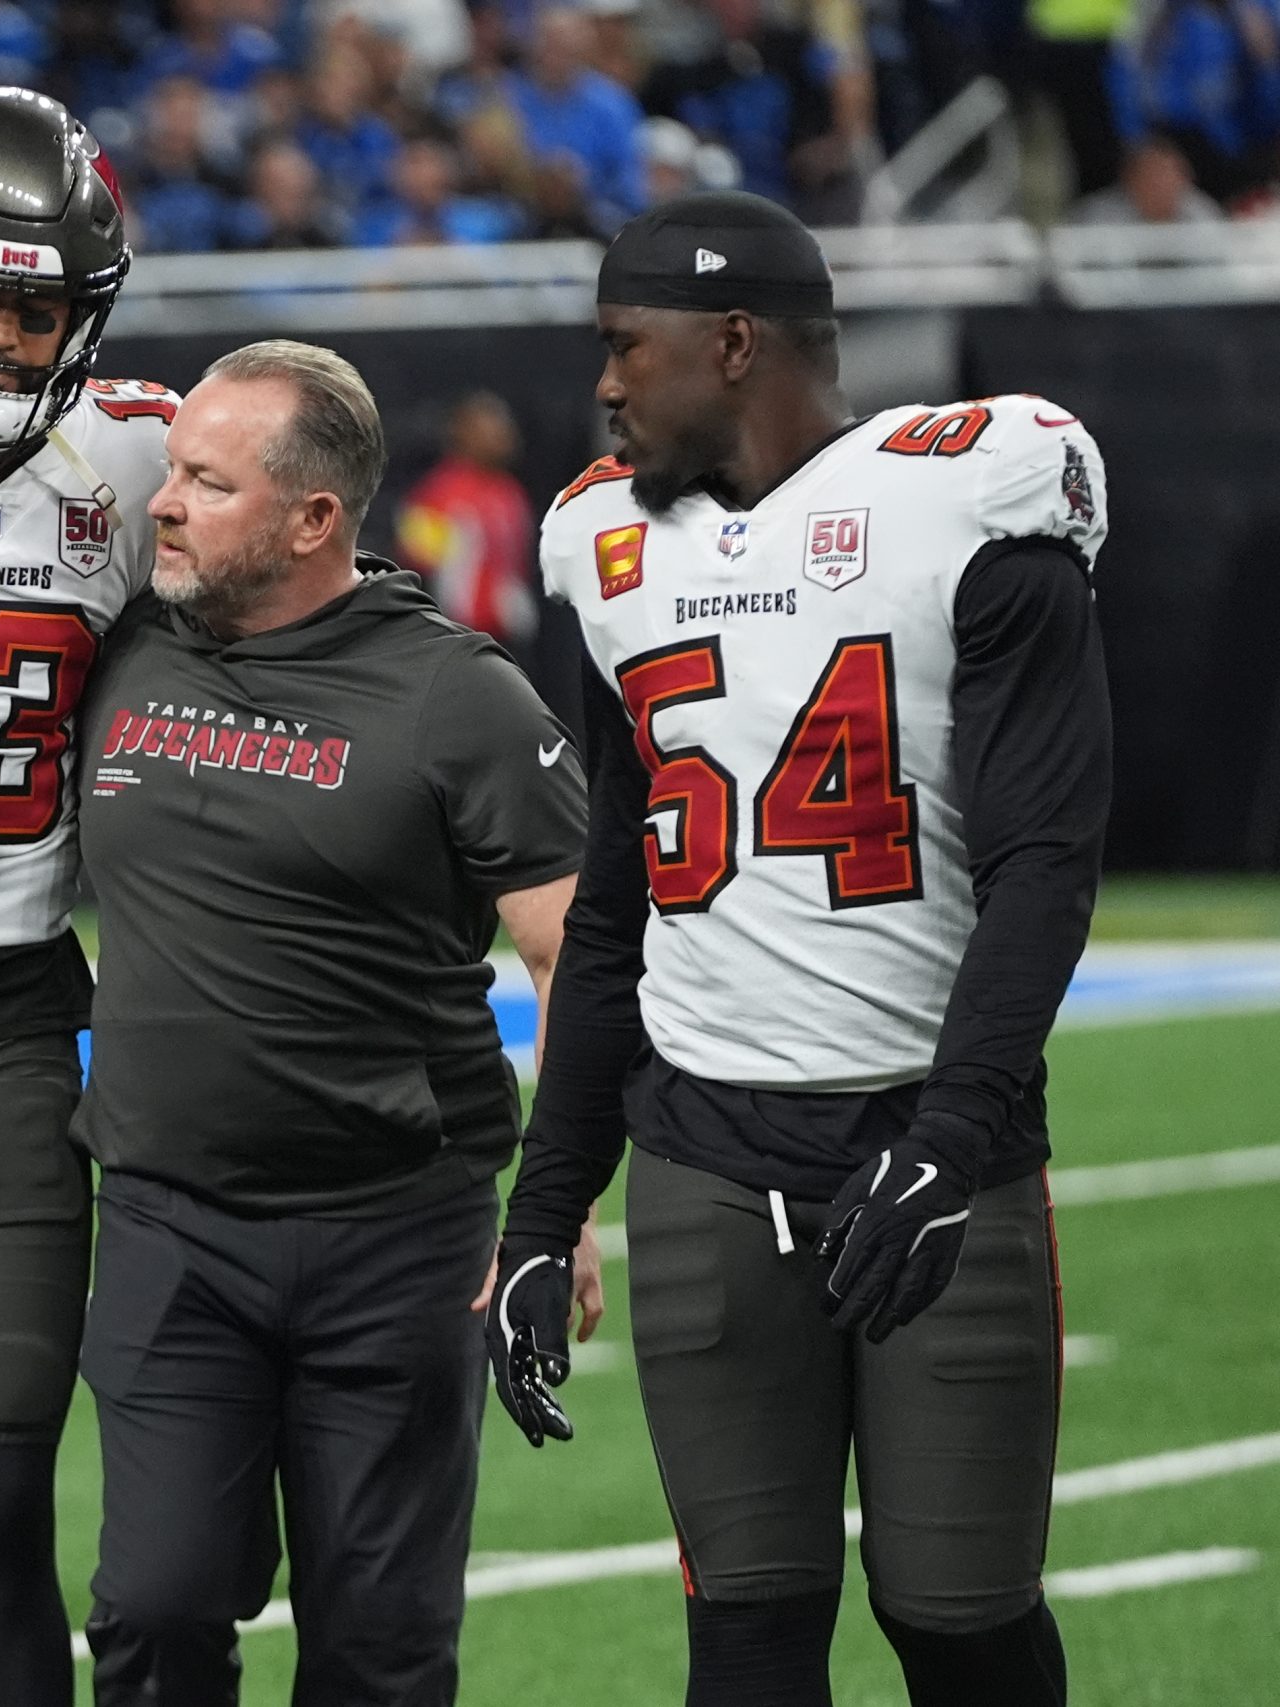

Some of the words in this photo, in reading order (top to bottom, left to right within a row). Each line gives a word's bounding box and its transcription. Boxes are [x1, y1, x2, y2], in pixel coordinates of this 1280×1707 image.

[877, 402, 995, 458] 5
[66, 506, 109, 544] 50
[811, 518, 859, 555] 50
[599, 526, 642, 578] C
[675, 587, 797, 624] BUCCANEERS
[147, 702, 236, 726] TAMPA
[254, 716, 308, 736] BAY
[103, 709, 351, 790] BUCCANEERS
[614, 632, 925, 917] 54
